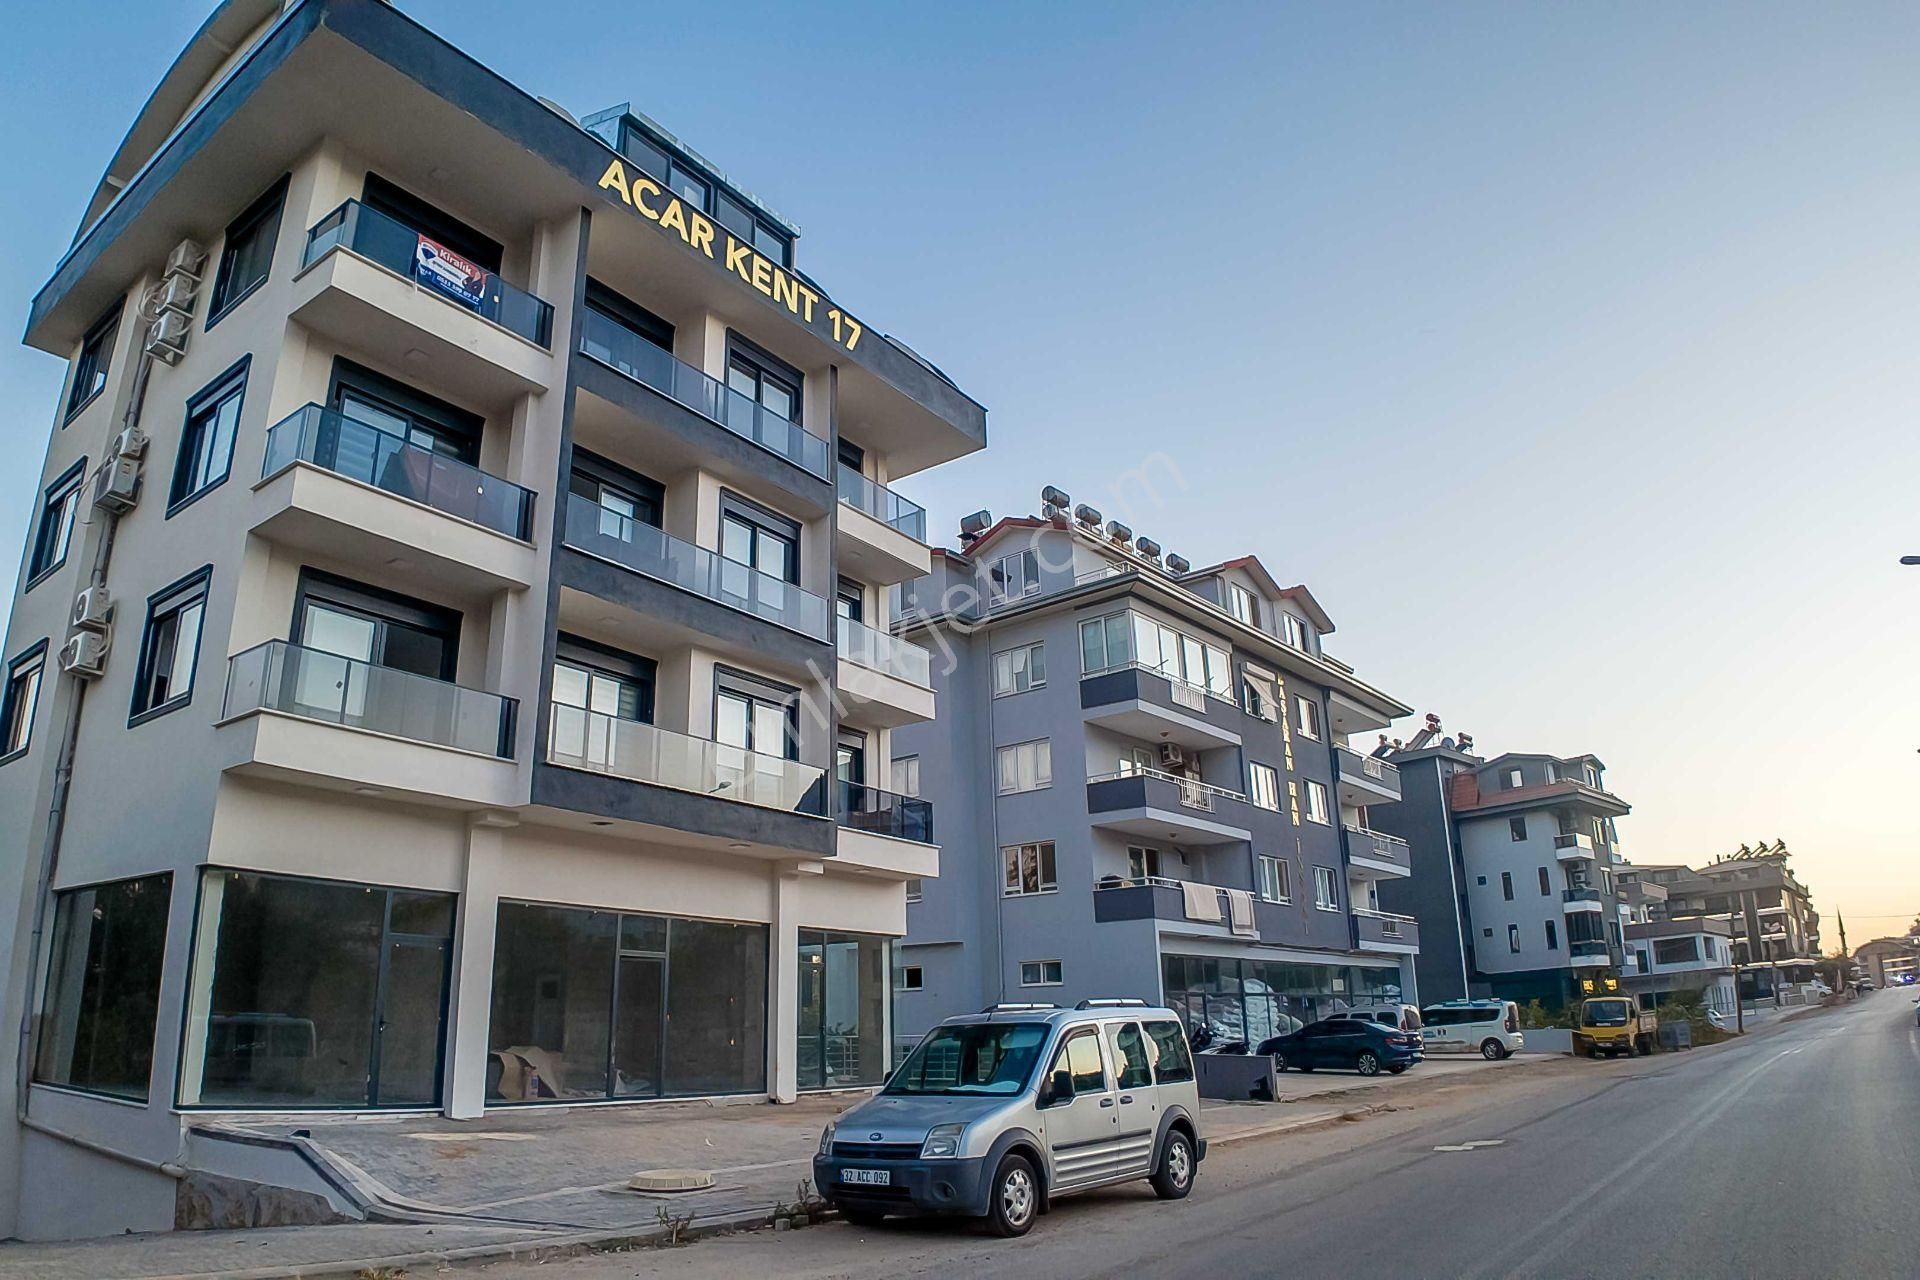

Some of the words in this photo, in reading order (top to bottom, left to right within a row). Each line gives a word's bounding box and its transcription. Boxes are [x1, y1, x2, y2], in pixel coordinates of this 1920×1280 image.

[598, 159, 714, 259] ACAR
[725, 235, 819, 323] KENT
[828, 309, 861, 351] 17
[844, 1170, 853, 1182] 32
[856, 1171, 870, 1182] ACC
[873, 1171, 888, 1184] 092
